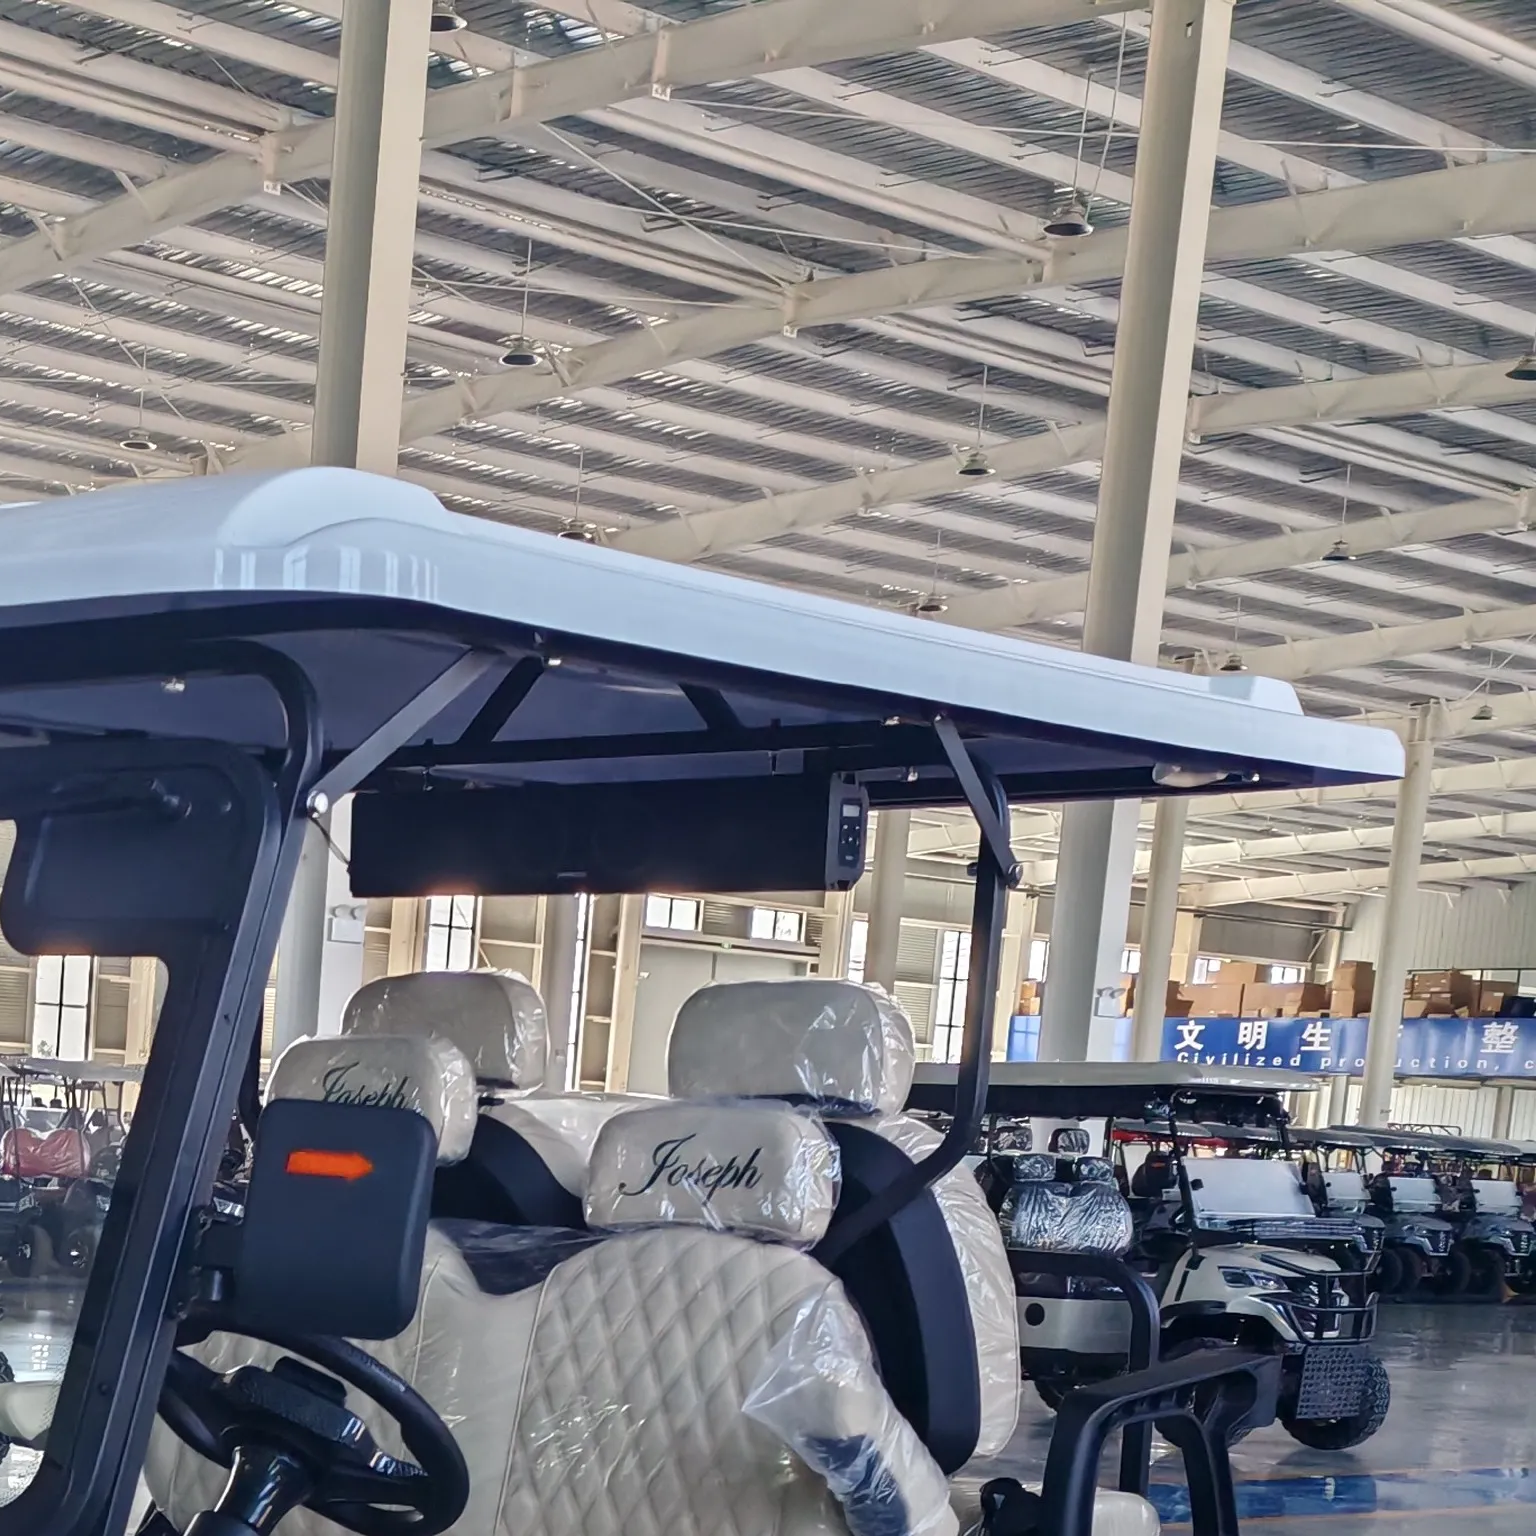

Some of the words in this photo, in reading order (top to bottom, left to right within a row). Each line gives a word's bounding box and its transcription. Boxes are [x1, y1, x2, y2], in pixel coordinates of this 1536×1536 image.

[1174, 1020, 1404, 1052] 文明生
[1480, 1021, 1519, 1053] 整
[1177, 1052, 1302, 1067] Civilized
[1320, 1056, 1500, 1071] prouction,
[618, 1133, 764, 1202] Joseph
